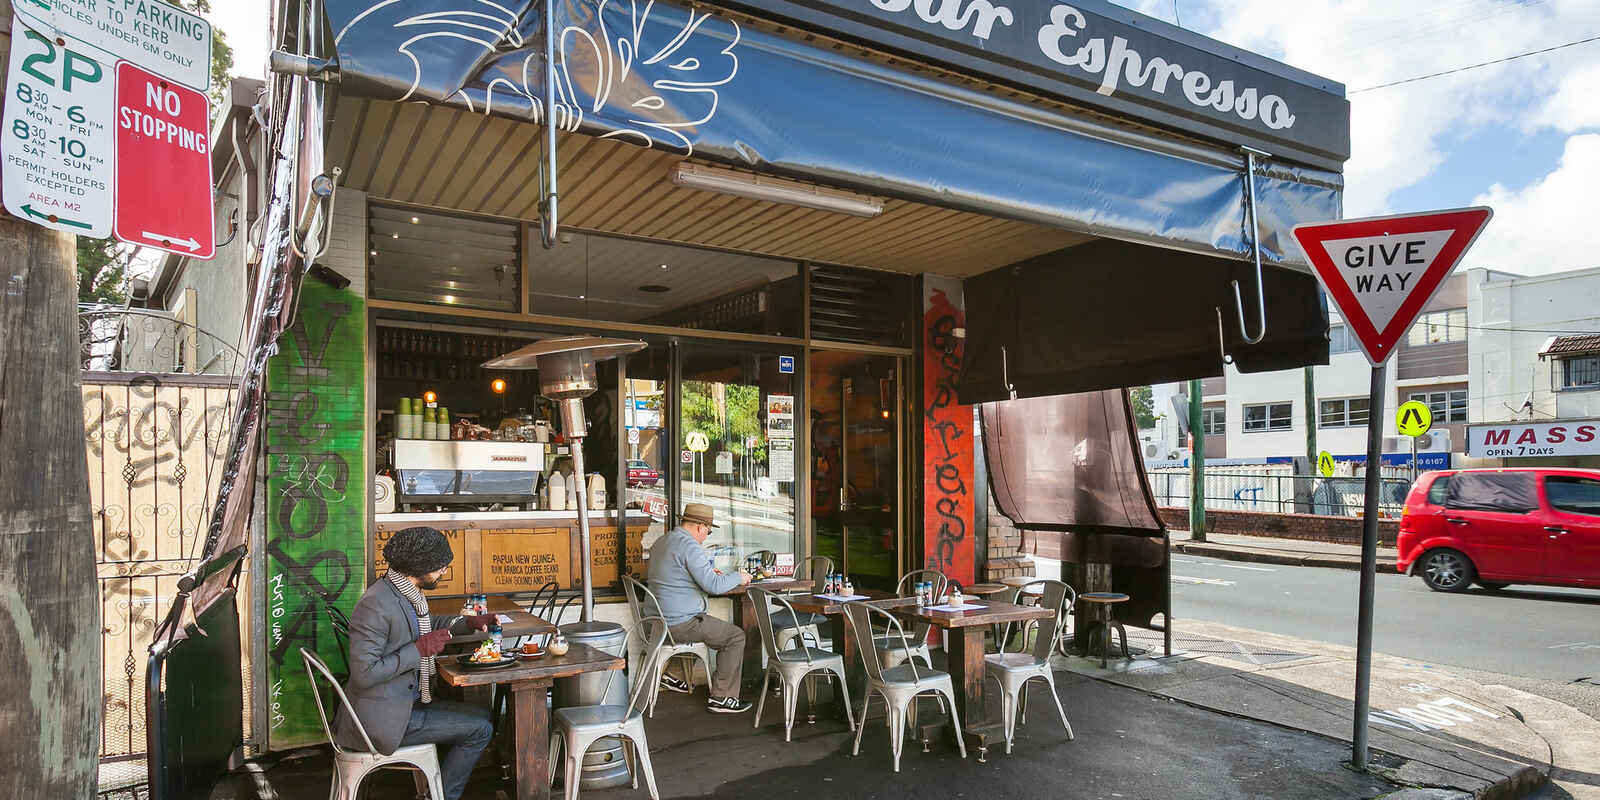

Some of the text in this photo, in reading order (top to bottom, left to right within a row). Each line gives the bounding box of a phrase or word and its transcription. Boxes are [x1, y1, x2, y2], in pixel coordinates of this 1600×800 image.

[107, 7, 124, 25] TO
[134, 19, 169, 45] KERB
[97, 20, 139, 46] UNDER
[143, 42, 160, 56] 6M
[163, 51, 193, 68] ONLY
[21, 29, 103, 93] 2P
[1037, 4, 1296, 131] Espresso
[146, 81, 181, 117] NO
[26, 107, 53, 125] MON
[70, 124, 91, 137] FRI
[120, 105, 206, 154] STOPPING
[23, 144, 46, 158] SAT
[63, 158, 91, 171] SUN
[8, 154, 106, 191] PERMIT HOLDERS
[26, 173, 85, 196] EXCEPTED
[29, 192, 82, 212] AREA M2
[1344, 240, 1426, 268] GIVE
[1356, 272, 1412, 293] WAY
[1484, 425, 1597, 446] MASS
[1486, 446, 1554, 456] OPEN 7 DAYS
[492, 553, 556, 564] PAPUA NEW GUINEA
